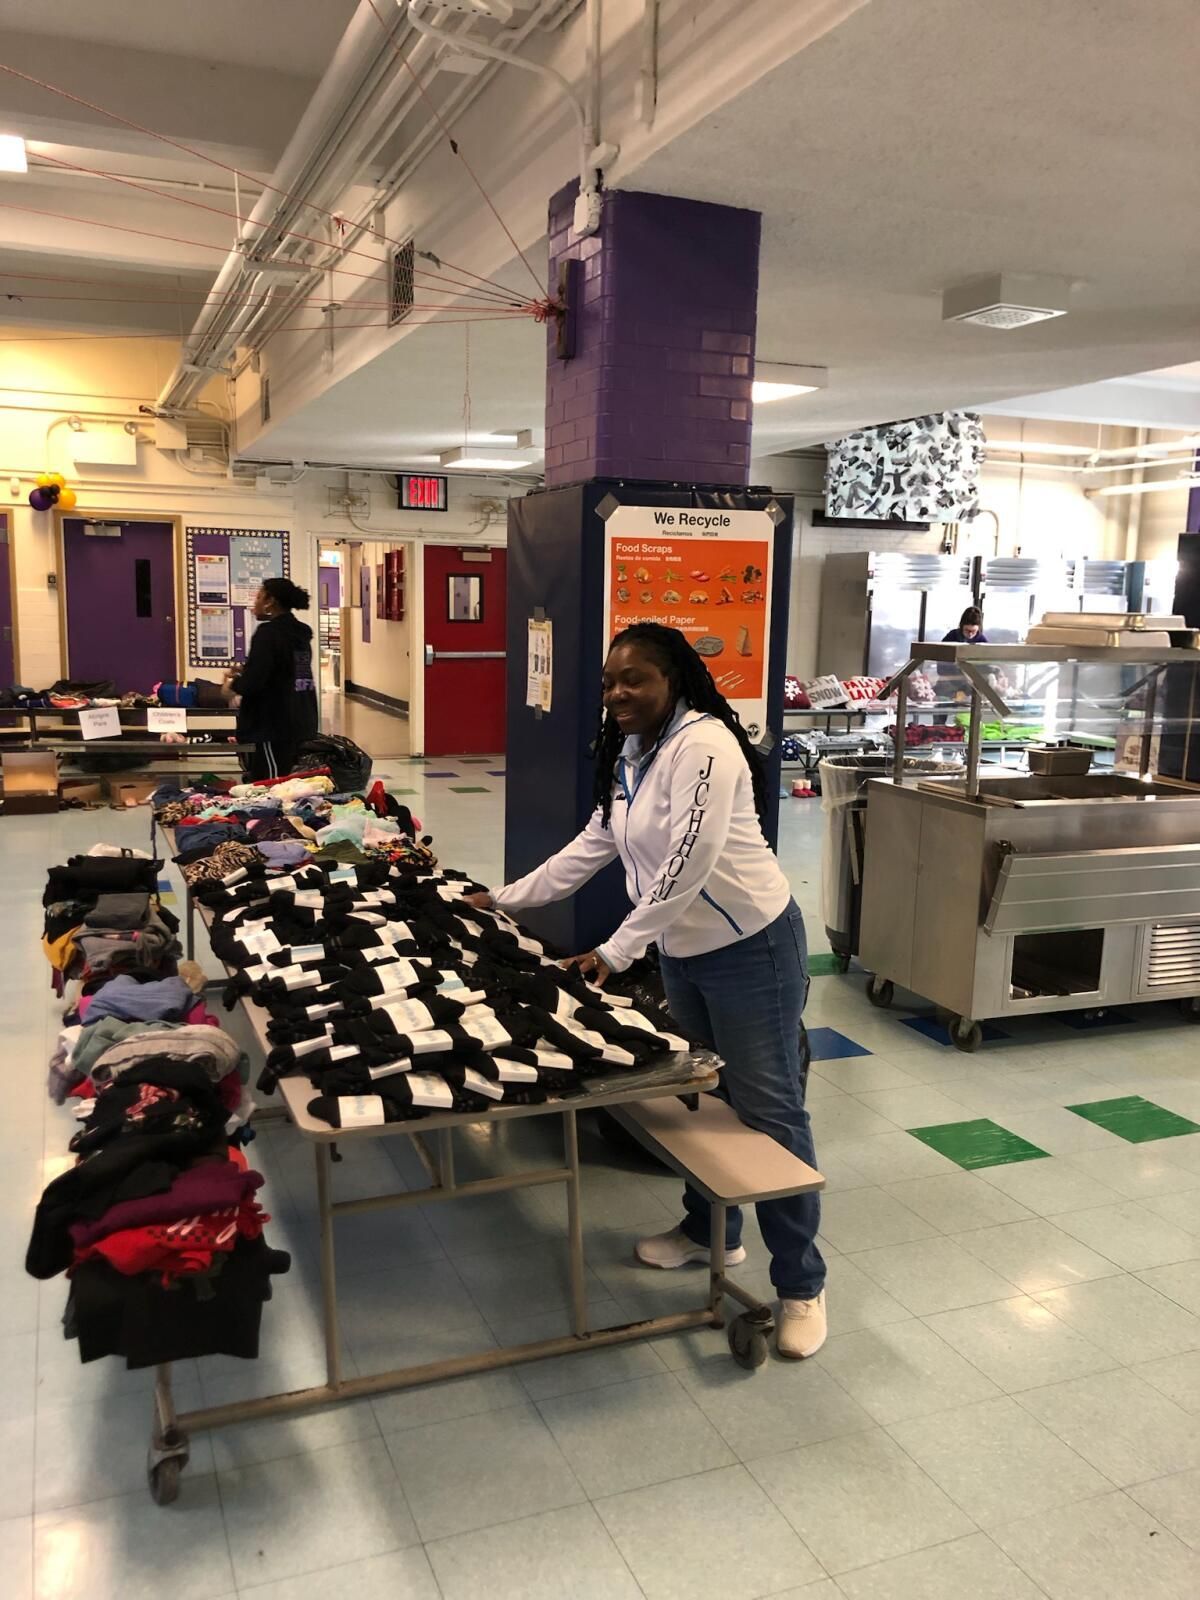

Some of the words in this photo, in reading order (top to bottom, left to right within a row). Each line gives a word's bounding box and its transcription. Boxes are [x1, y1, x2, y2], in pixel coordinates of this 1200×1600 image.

[654, 511, 675, 525] We
[679, 512, 731, 528] Recycle
[616, 543, 640, 553] Food
[641, 544, 673, 555] Scraps
[669, 616, 696, 625] Paper
[808, 687, 842, 704] SNOW
[849, 689, 865, 700] LA
